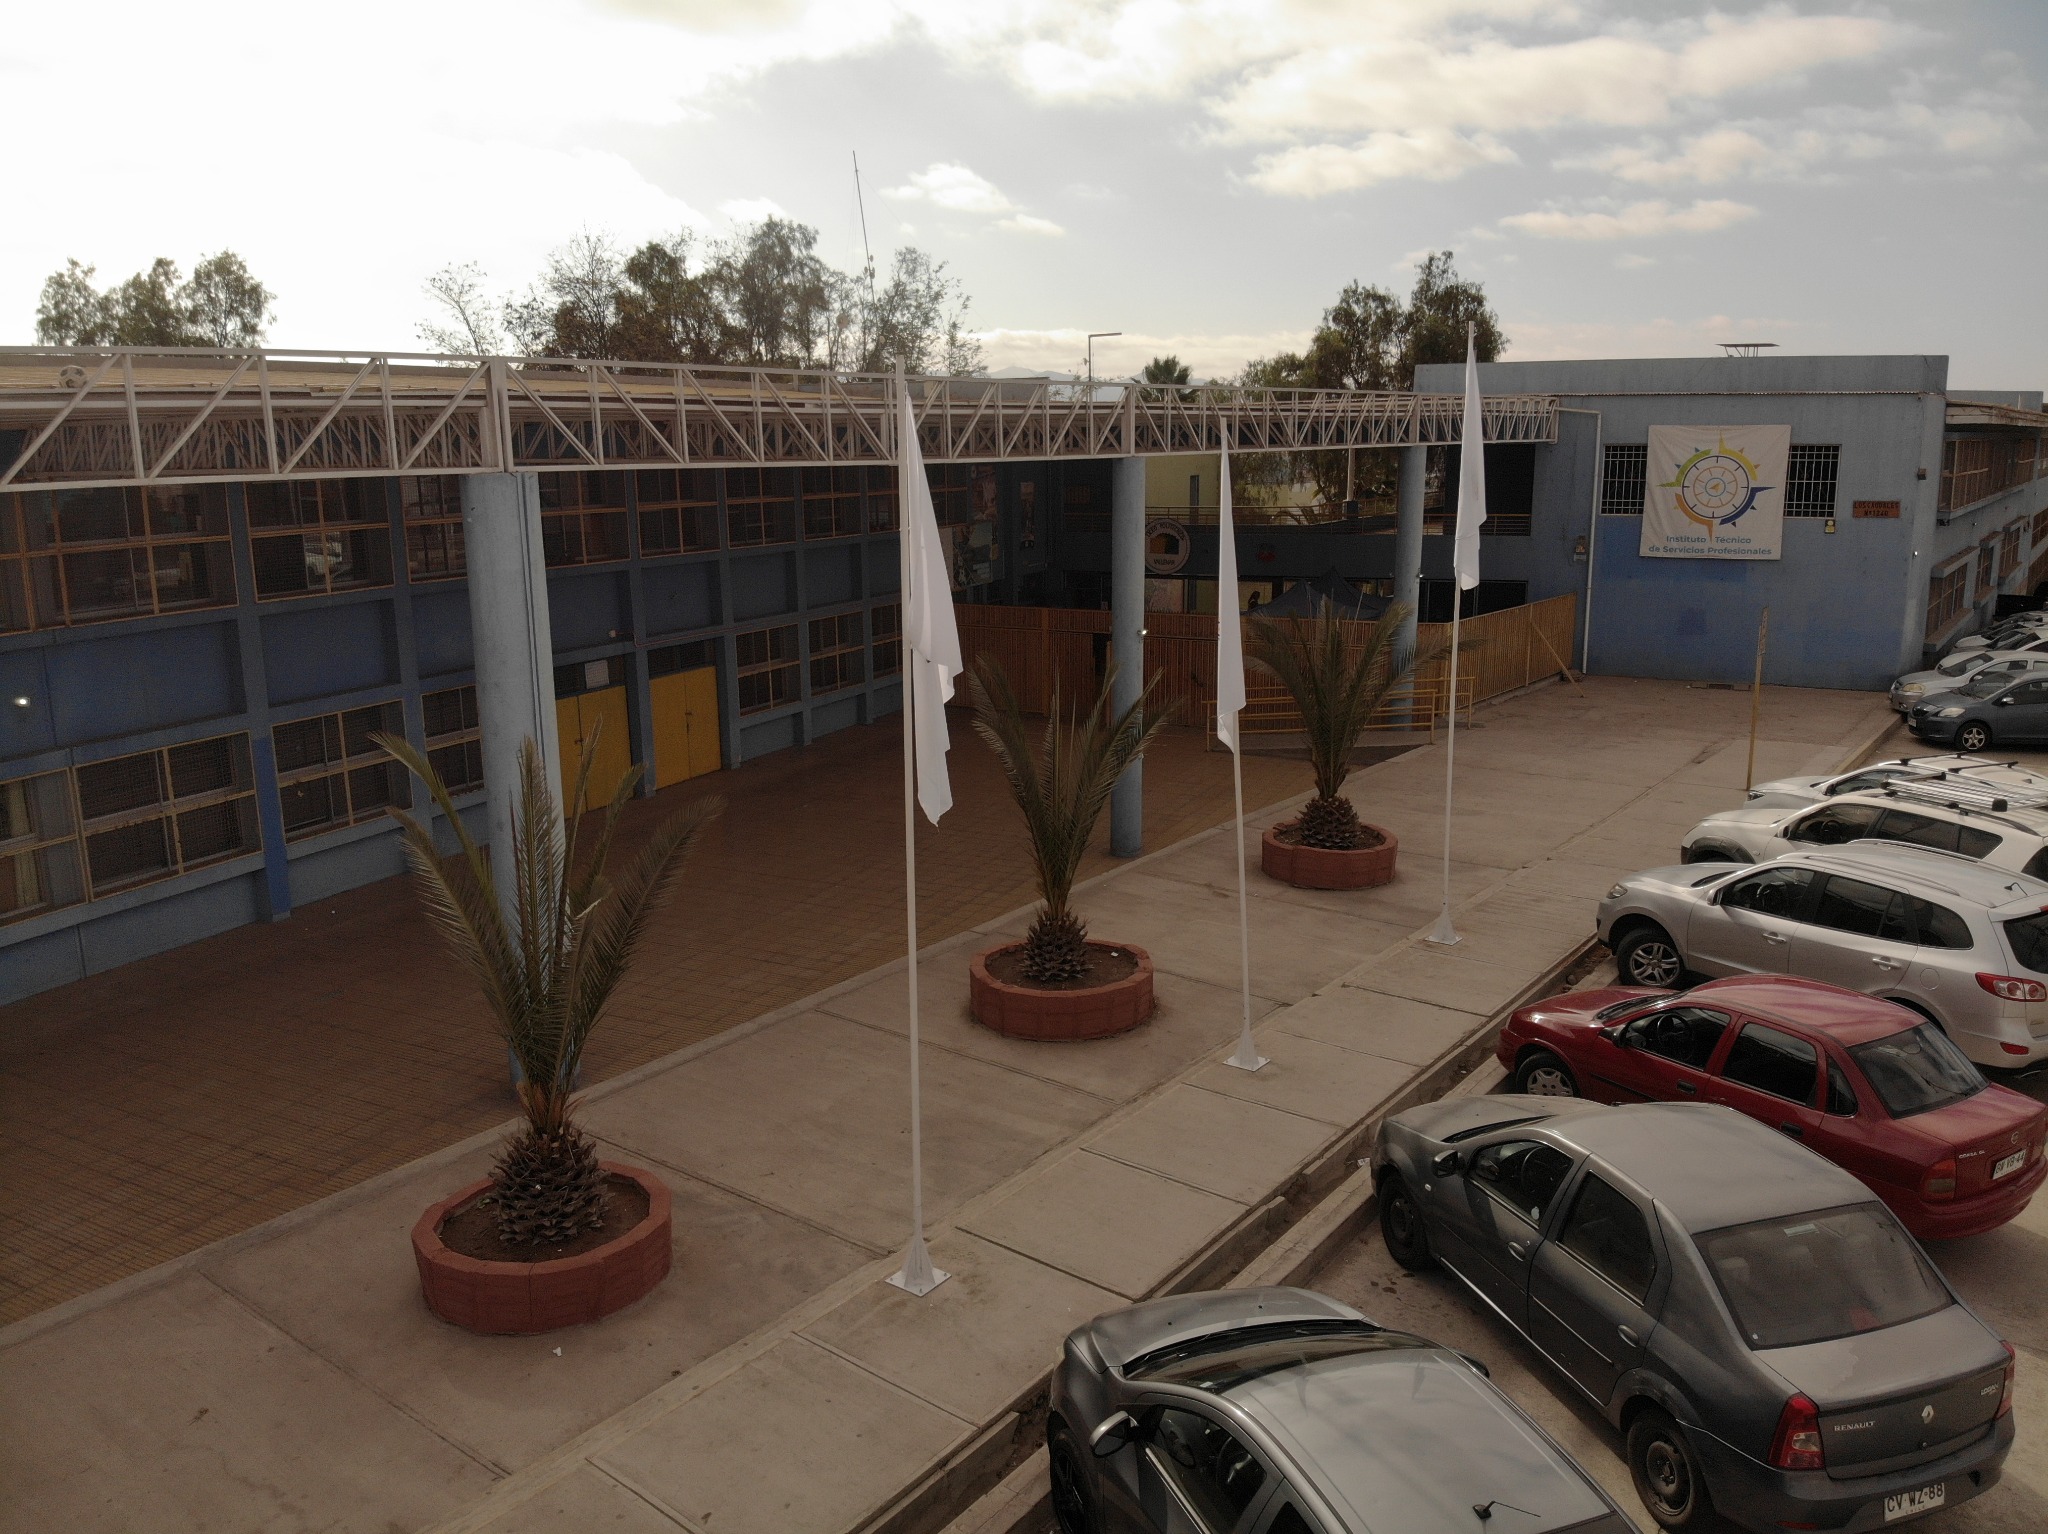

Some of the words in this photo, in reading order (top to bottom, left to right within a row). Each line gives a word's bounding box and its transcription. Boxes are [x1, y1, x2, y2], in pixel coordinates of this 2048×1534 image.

[1666, 535, 1707, 543] Instituto
[1715, 535, 1752, 544] Técnico
[1648, 545, 1661, 553] de
[1662, 545, 1705, 554] Servicios
[1707, 546, 1772, 555] Profesionales
[1834, 1420, 1876, 1431] RENAULT
